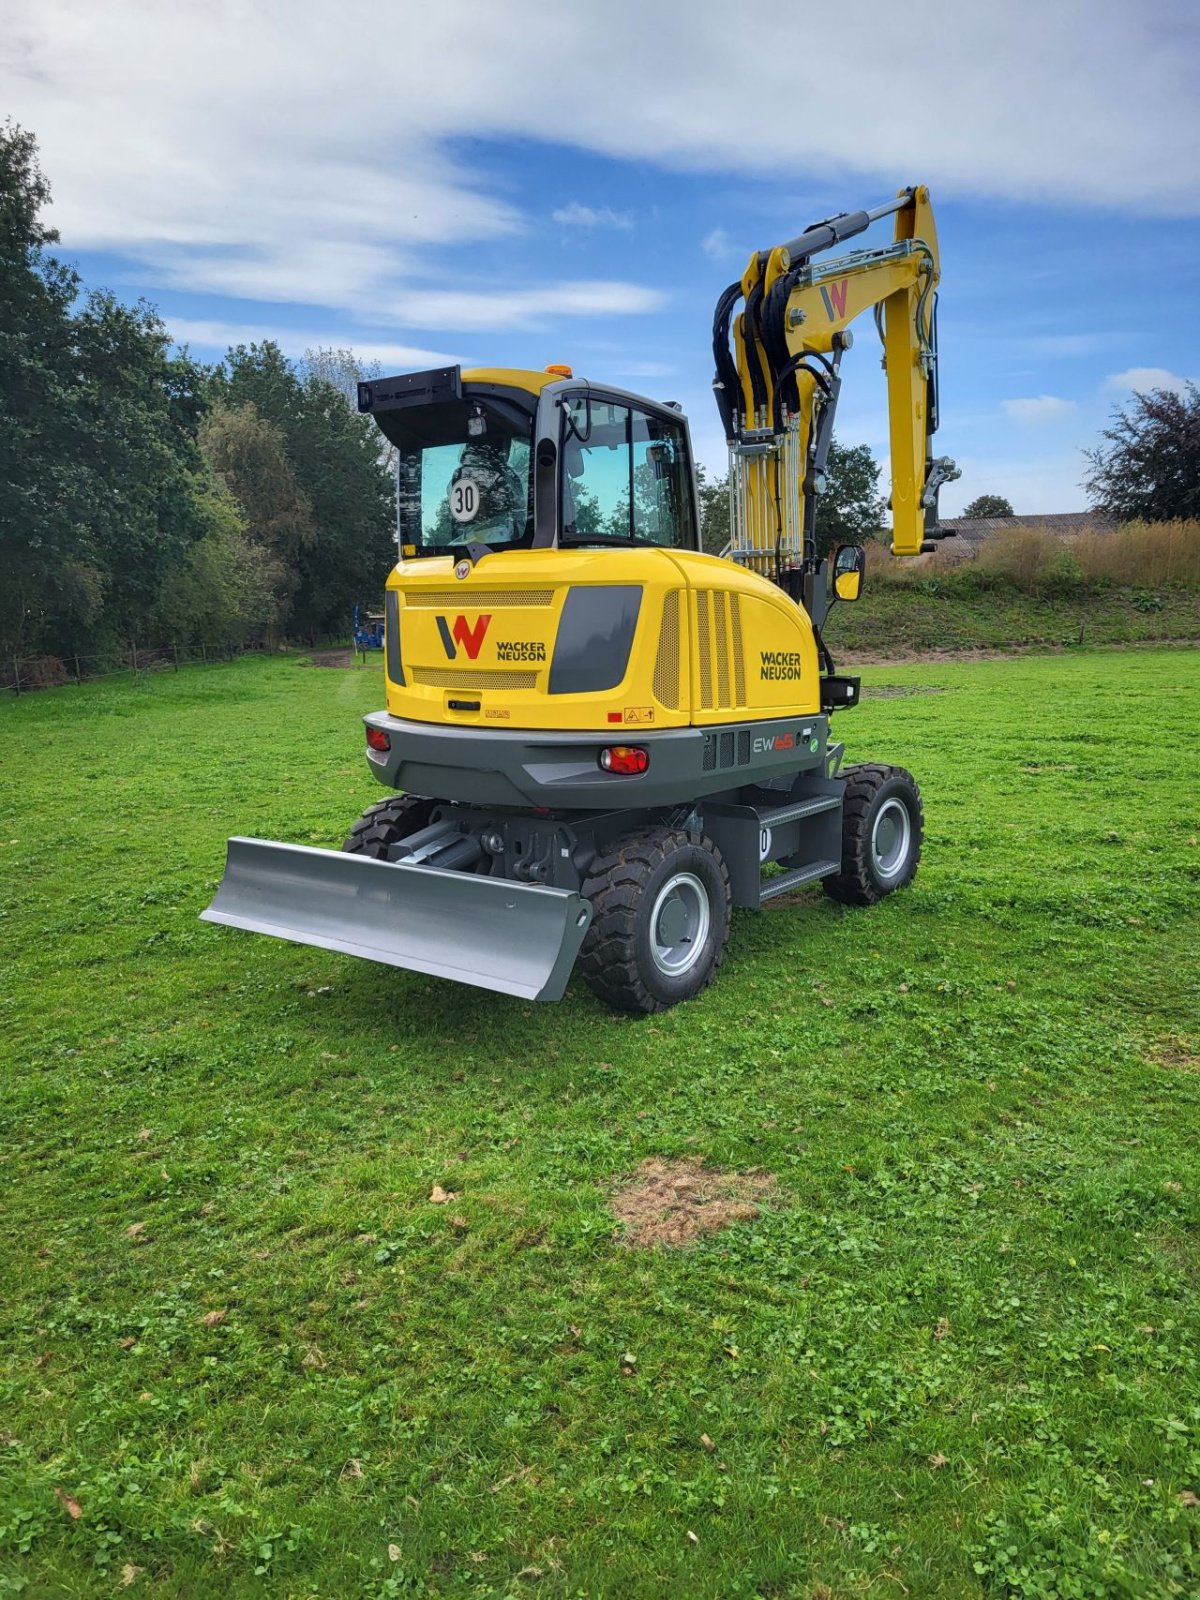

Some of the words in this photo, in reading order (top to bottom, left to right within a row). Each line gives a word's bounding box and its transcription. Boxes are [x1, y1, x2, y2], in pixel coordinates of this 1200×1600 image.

[455, 486, 474, 514] 30
[496, 642, 546, 652] WACKER
[497, 652, 546, 661] NEUSON
[760, 652, 801, 667] WACKER
[760, 667, 801, 680] NEUSON
[753, 732, 795, 753] EW65
[761, 829, 768, 853] 0
